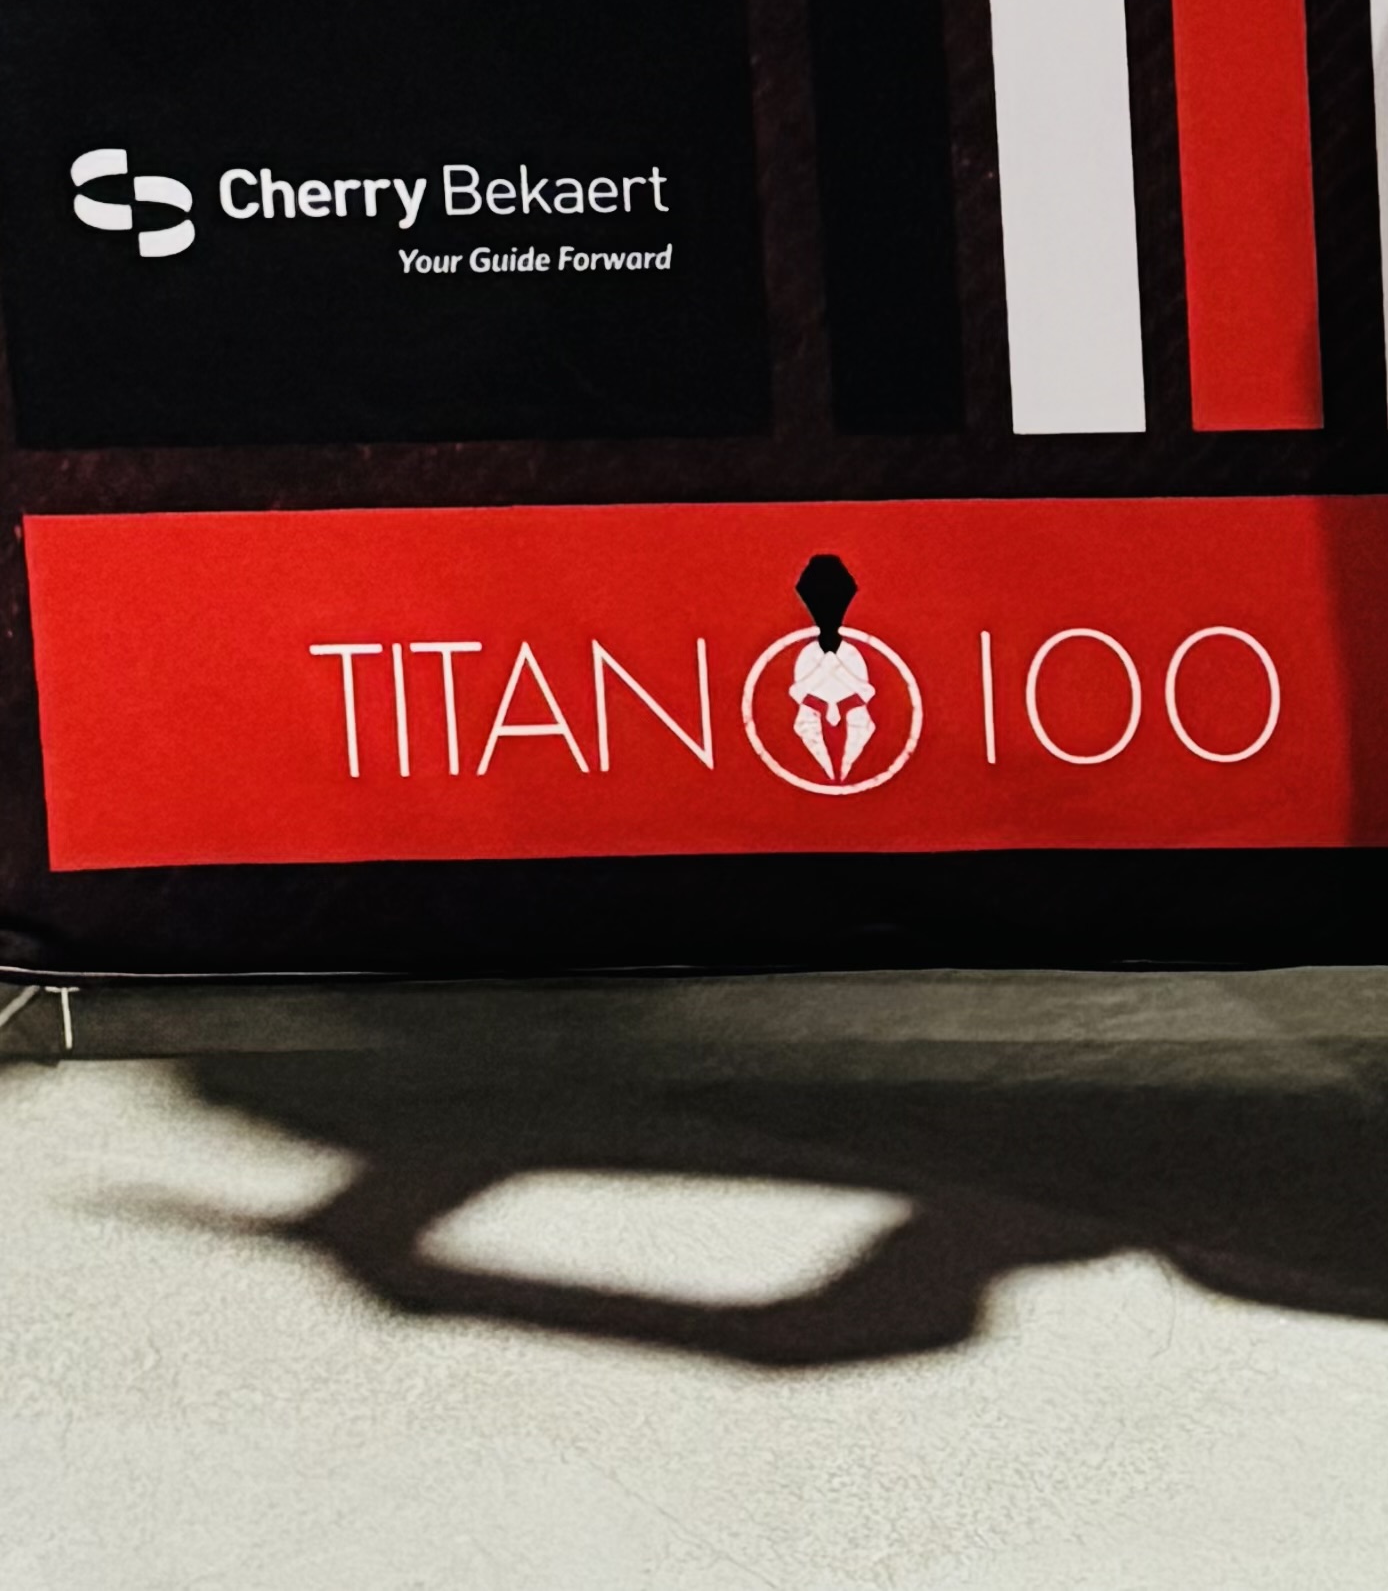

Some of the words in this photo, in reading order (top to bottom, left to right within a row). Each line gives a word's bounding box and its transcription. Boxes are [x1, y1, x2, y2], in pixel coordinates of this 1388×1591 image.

[219, 168, 427, 230] Cherry
[442, 164, 670, 216] Bekaert
[398, 248, 463, 274] Your
[469, 246, 551, 273] Guide
[558, 243, 673, 271] Forward
[309, 638, 714, 778] TITAN
[980, 626, 1281, 765] 100
